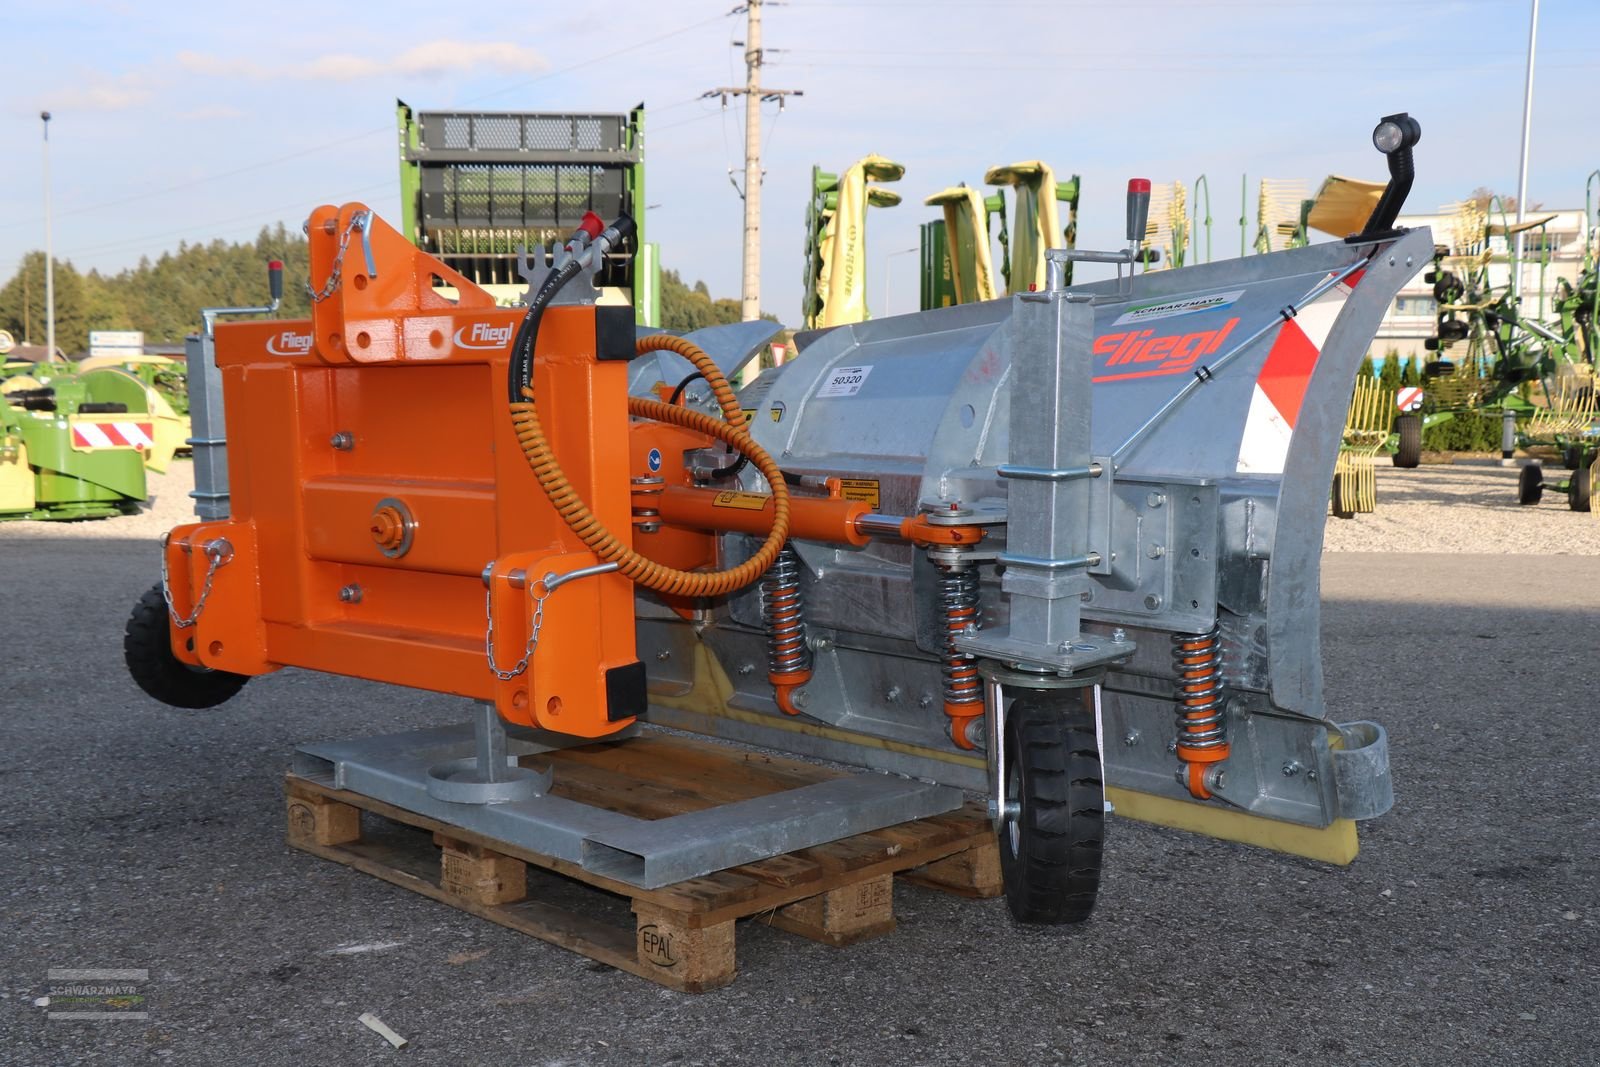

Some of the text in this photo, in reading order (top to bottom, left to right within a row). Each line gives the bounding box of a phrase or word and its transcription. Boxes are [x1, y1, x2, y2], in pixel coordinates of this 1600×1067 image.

[280, 331, 314, 351] Fliegl
[471, 321, 514, 345] Fliegl
[1092, 317, 1241, 369] Fliegl
[832, 375, 863, 385] 50320
[643, 931, 674, 961] EPAL
